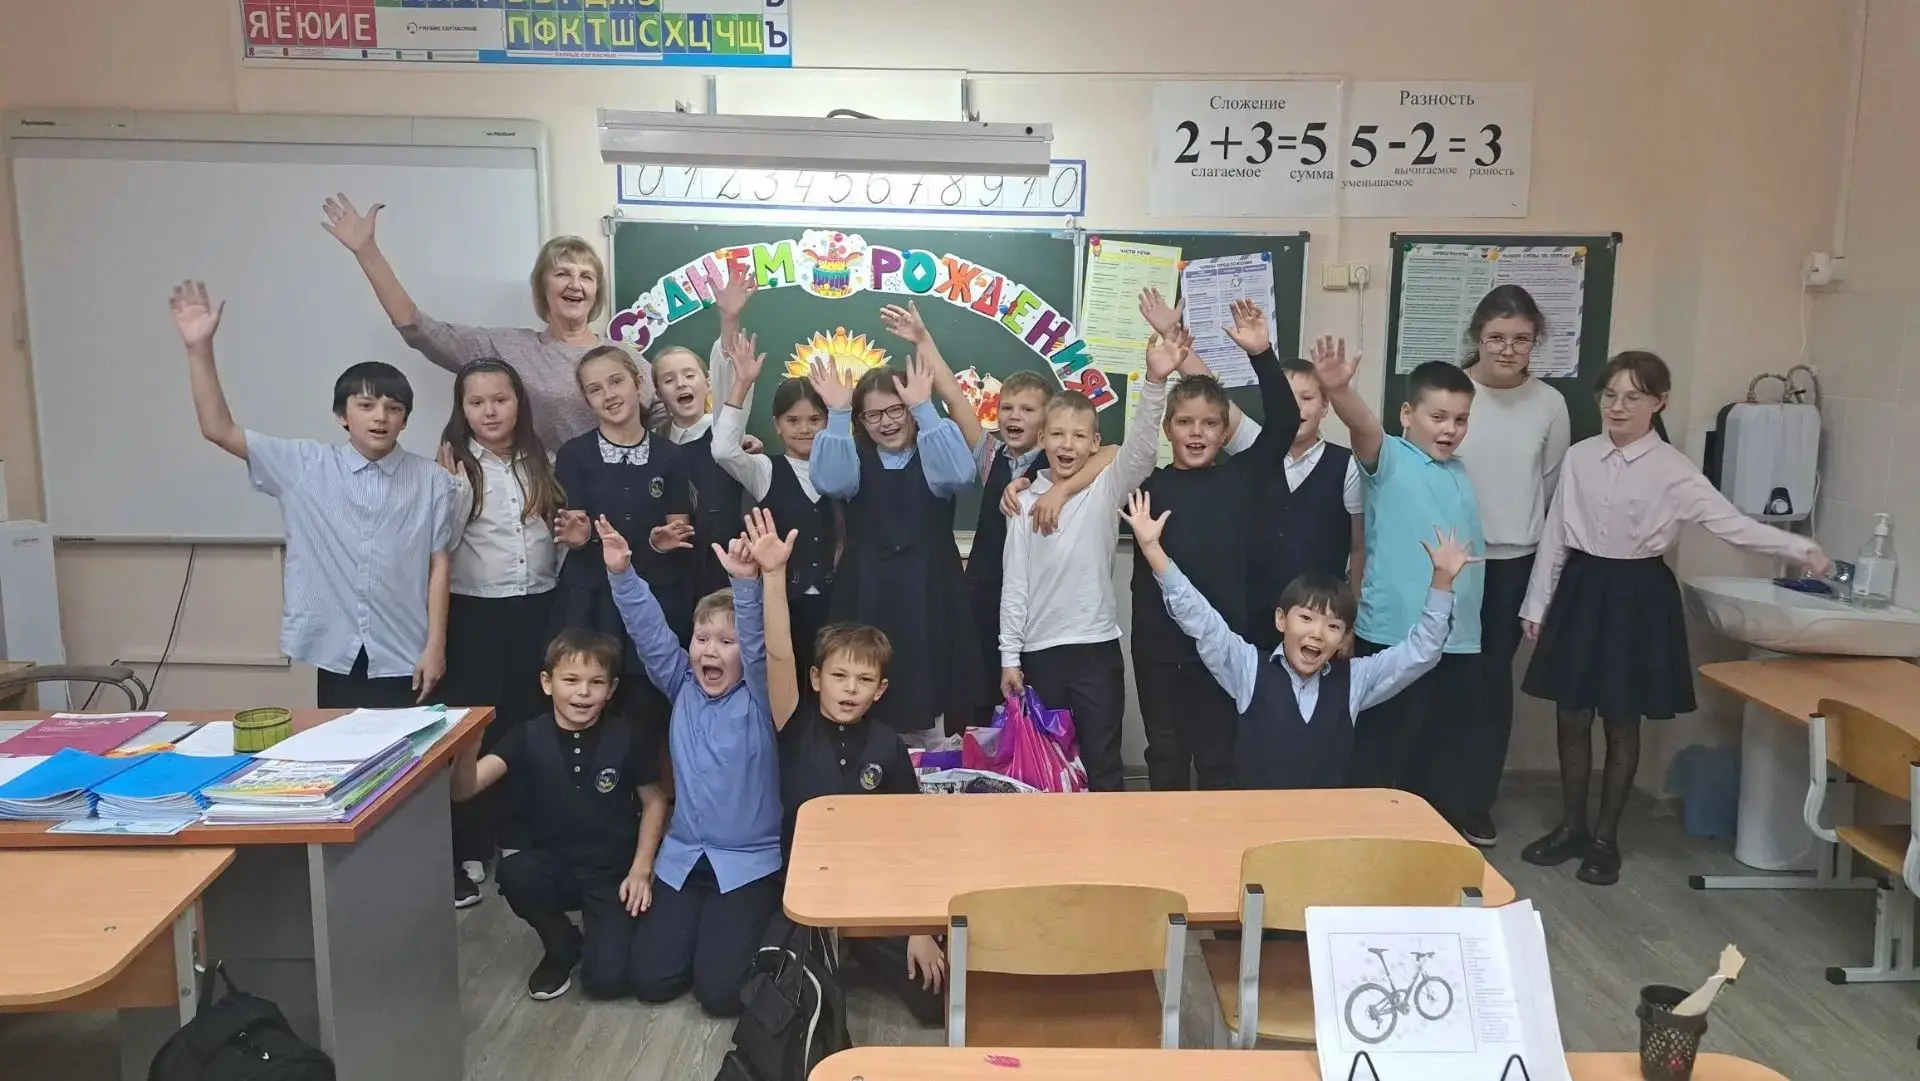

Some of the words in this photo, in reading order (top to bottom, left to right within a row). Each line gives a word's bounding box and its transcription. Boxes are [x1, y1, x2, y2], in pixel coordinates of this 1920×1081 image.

[1209, 95, 1287, 111] Сложение
[1399, 90, 1476, 107] Разность
[1190, 167, 1262, 179] слагаемое
[1289, 169, 1335, 181] сумма
[1394, 166, 1458, 176] вычитаемое
[1468, 167, 1516, 179] разность
[1340, 178, 1415, 190] уменьшаемое
[609, 311, 650, 352] С
[663, 242, 796, 323] ДНЕМ
[871, 247, 1116, 408] РОЖДЕНИЯ
